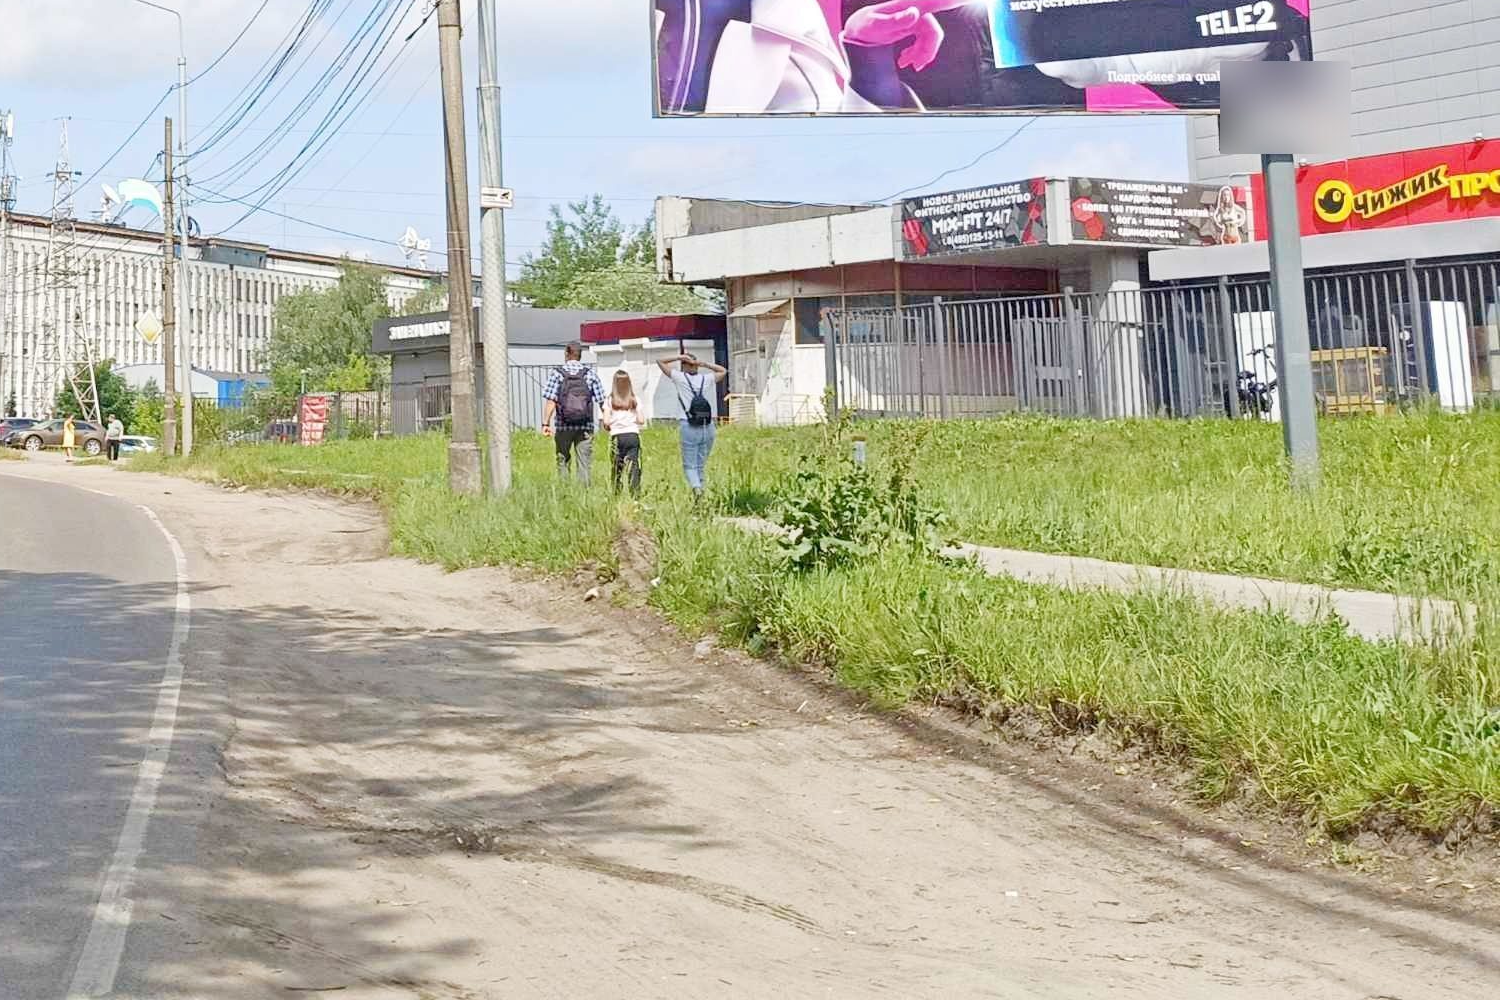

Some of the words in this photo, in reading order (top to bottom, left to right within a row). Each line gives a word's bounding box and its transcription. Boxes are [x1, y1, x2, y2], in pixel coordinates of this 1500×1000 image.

[1196, 1, 1277, 36] TELE2
[1108, 71, 1174, 84] Подробнее
[1196, 71, 1220, 85] qual
[922, 194, 955, 208] НОВОЕ
[956, 183, 1020, 203] УНИКАЛЬНОЕ
[1354, 167, 1441, 216] ЧИЖИК
[914, 192, 1031, 218] ФИТНЕС-ПРОСТРАНСТВО
[931, 211, 984, 235] MIX-FIT
[985, 208, 1012, 227] 24/7
